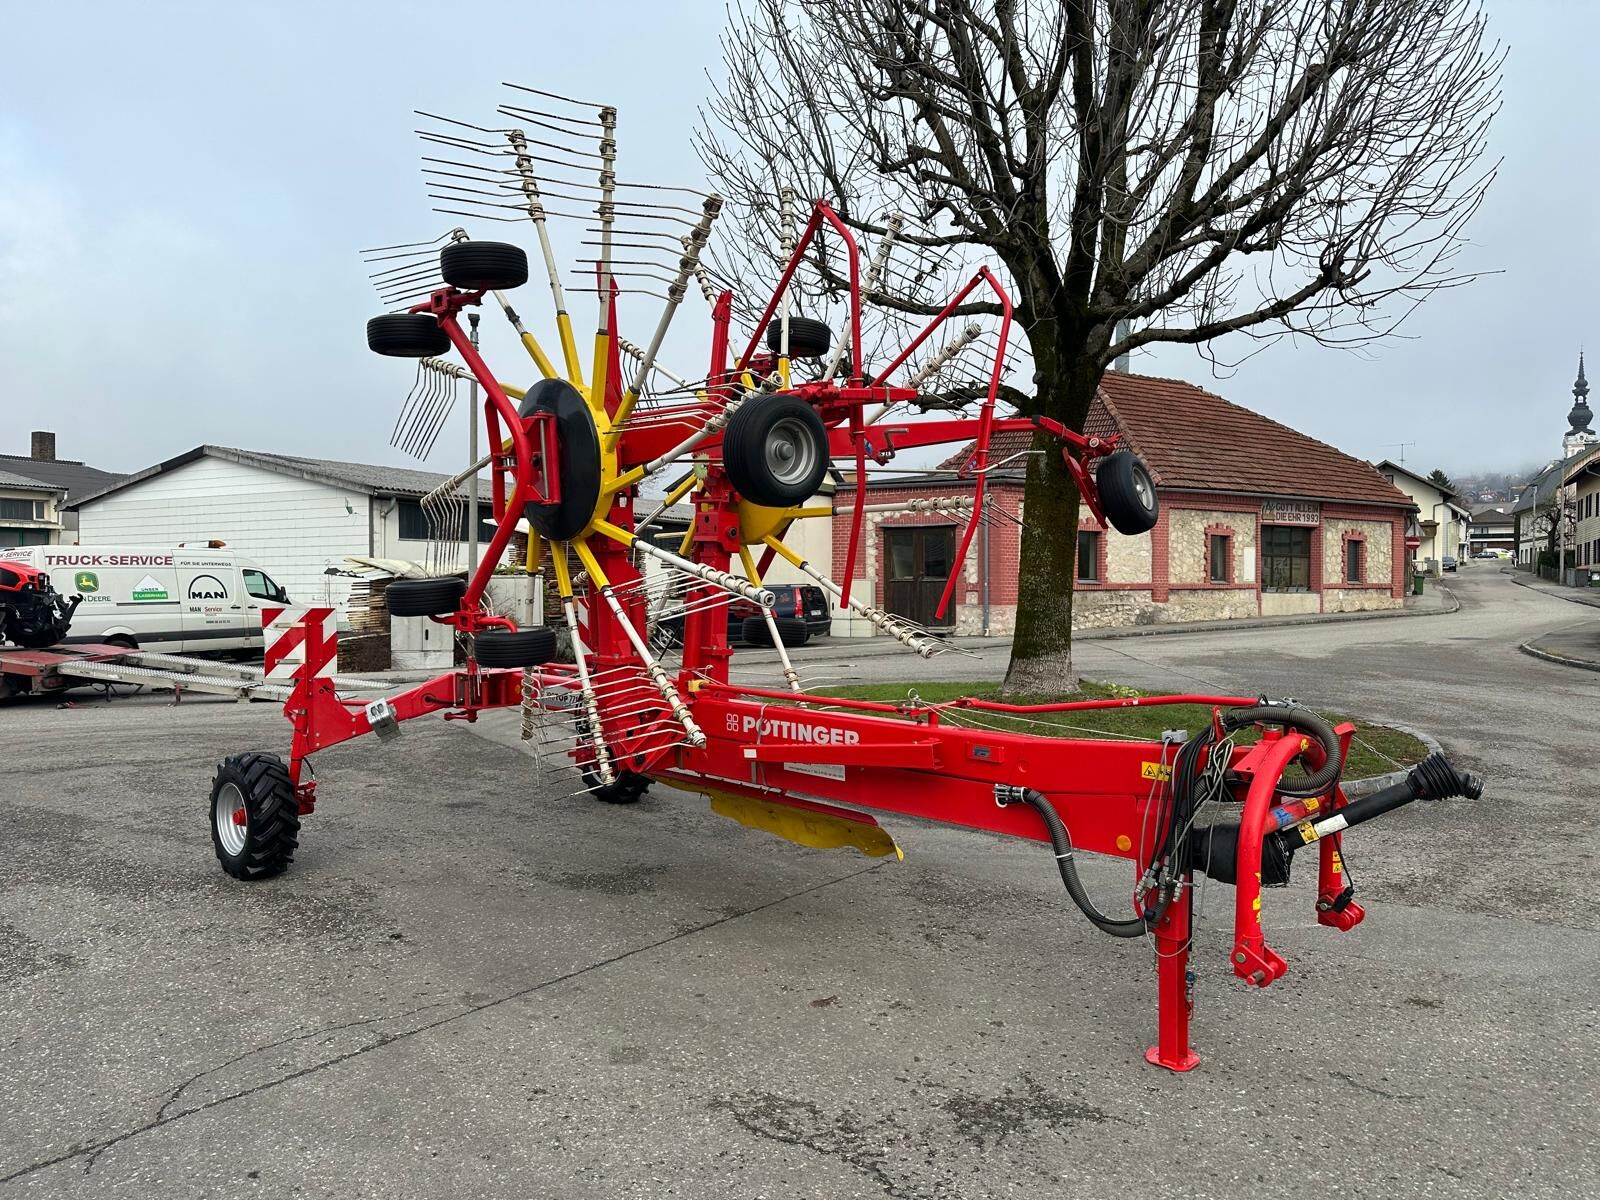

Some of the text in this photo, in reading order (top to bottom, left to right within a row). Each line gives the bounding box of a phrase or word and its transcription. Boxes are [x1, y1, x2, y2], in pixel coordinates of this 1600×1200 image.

[1276, 502, 1318, 513] GOTT ALLEIN
[1276, 512, 1287, 521] DIE
[1303, 513, 1319, 523] 1993
[45, 555, 173, 566] TRUCK-SERVICE
[191, 591, 225, 599] MAN
[743, 715, 860, 745] PÖTTINGER
